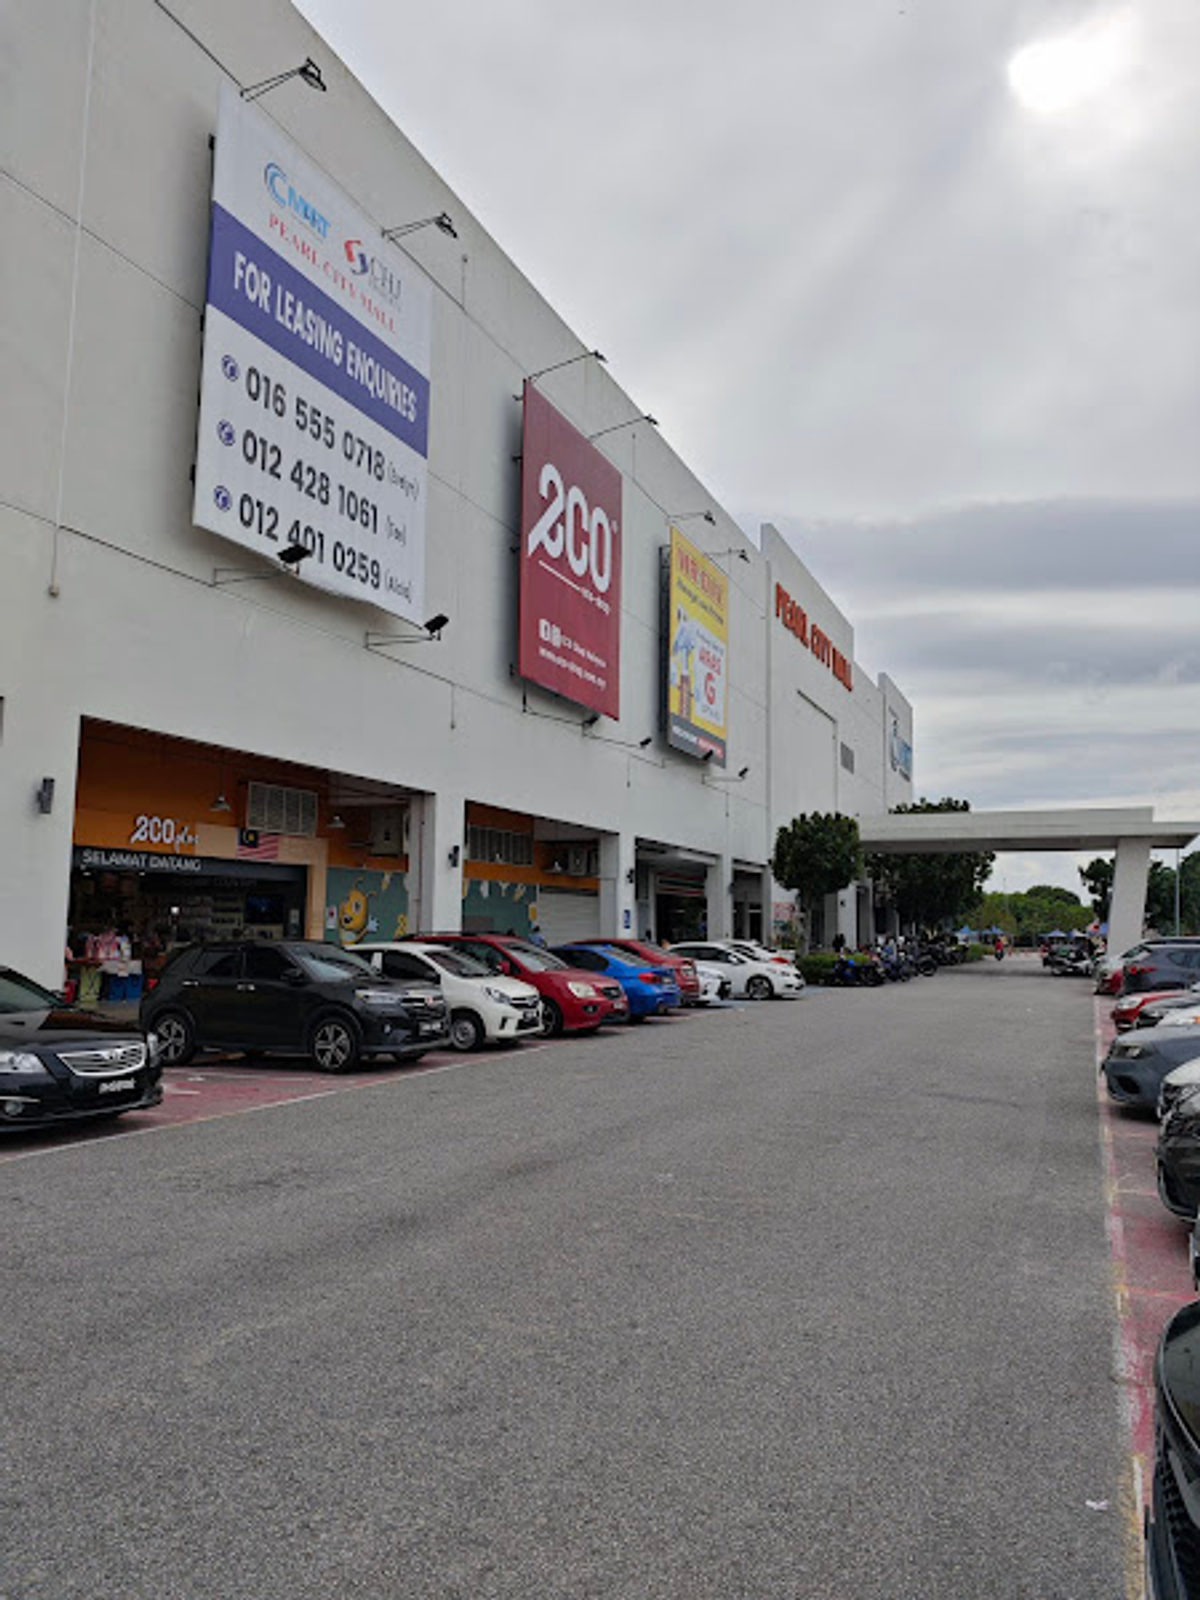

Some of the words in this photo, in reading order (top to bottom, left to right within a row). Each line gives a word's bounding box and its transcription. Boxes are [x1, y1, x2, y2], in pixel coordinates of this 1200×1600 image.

[268, 211, 321, 268] PEARL
[322, 260, 357, 299] CITY
[360, 292, 396, 335] MALL
[234, 250, 271, 314] FOR
[275, 283, 344, 367] LEASING
[346, 340, 417, 423] ENQUIRIES
[245, 365, 287, 419] 016
[295, 395, 336, 450] 555
[342, 430, 386, 483] 0718
[242, 428, 283, 482] 012
[289, 458, 331, 507] 428
[338, 483, 378, 536] 1061
[239, 492, 280, 544] 012
[286, 519, 325, 565] 401
[332, 540, 381, 591] 0259
[775, 581, 810, 649] PEARL
[810, 623, 832, 669] CITY
[81, 847, 147, 869] SELAMAT
[149, 855, 202, 872] DATANG
